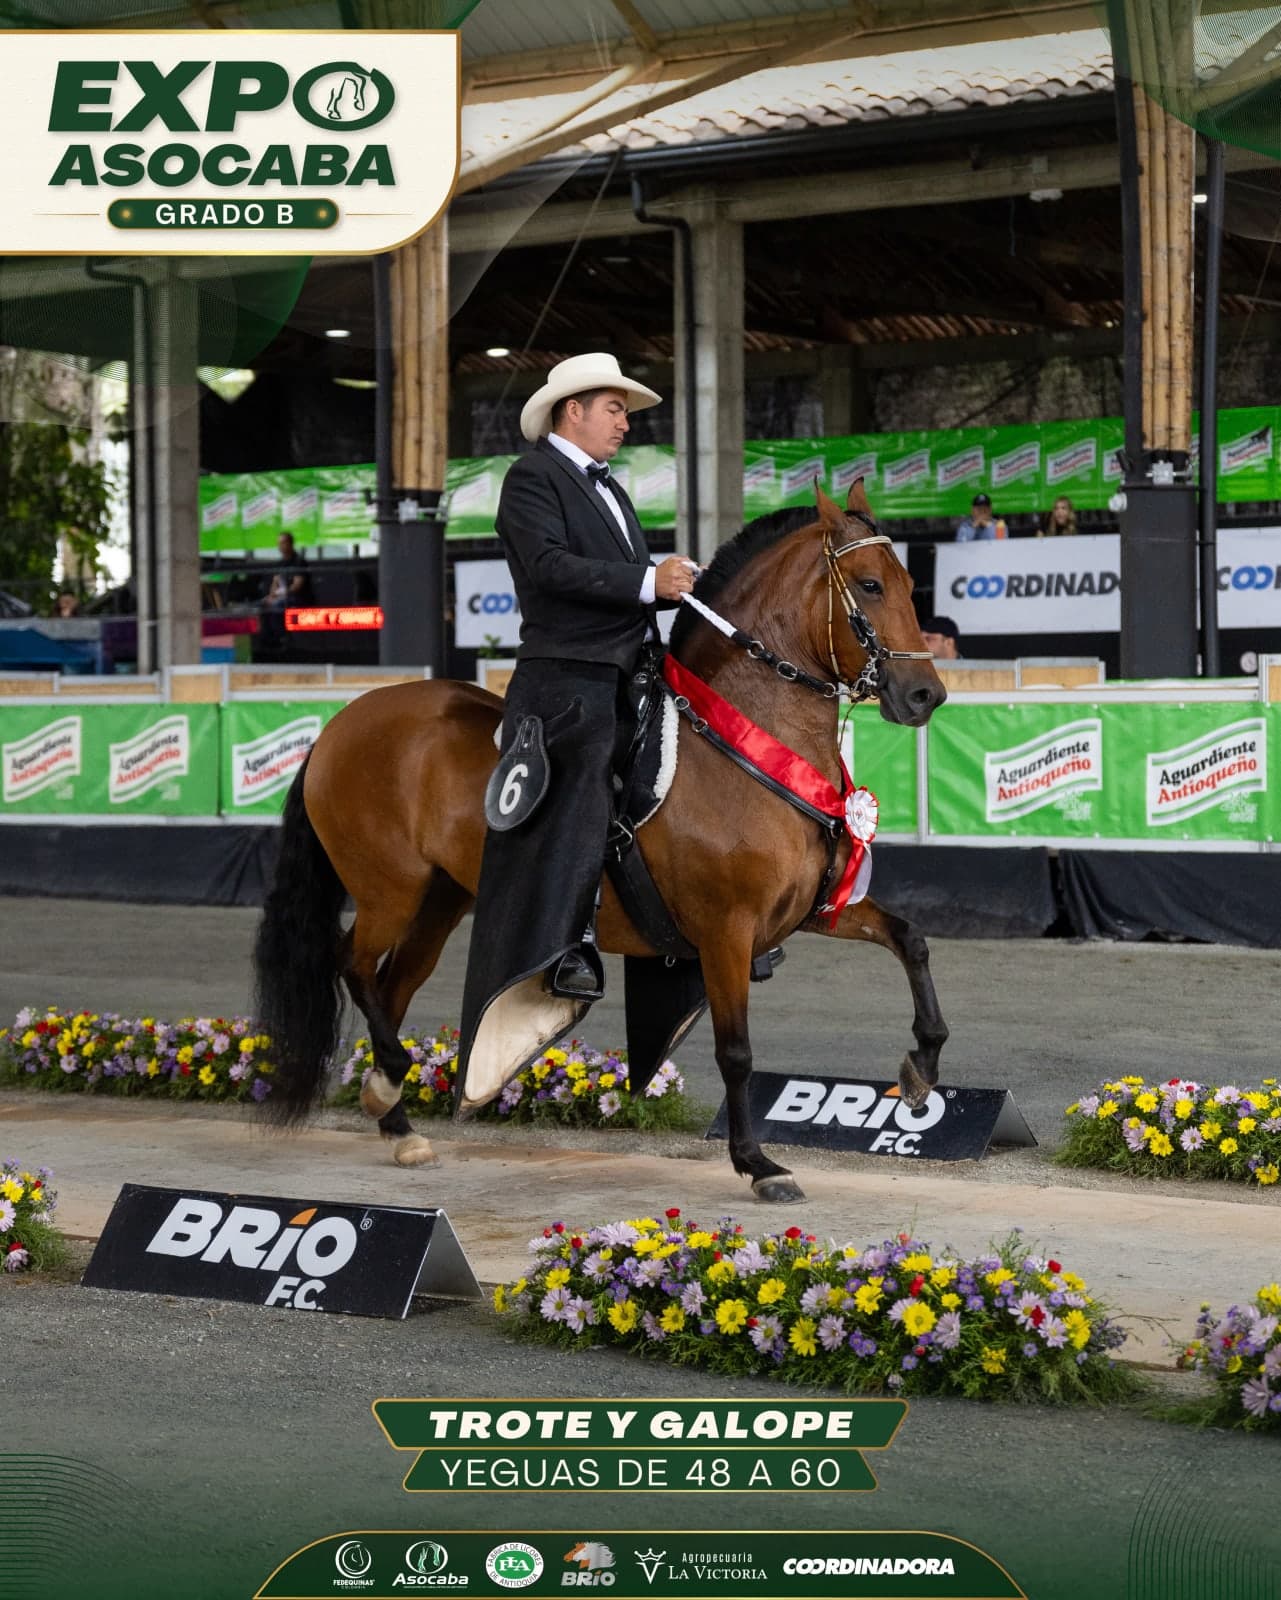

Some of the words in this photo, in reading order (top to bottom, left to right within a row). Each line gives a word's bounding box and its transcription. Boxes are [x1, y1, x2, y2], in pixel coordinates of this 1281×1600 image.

[951, 571, 1121, 599] COORDINAD
[997, 741, 1090, 784] Aguardiente
[997, 755, 1092, 802] Antioqueño
[1157, 755, 1258, 805] Antioqueño
[1159, 740, 1257, 786] Aguardiente
[499, 763, 529, 815] 6
